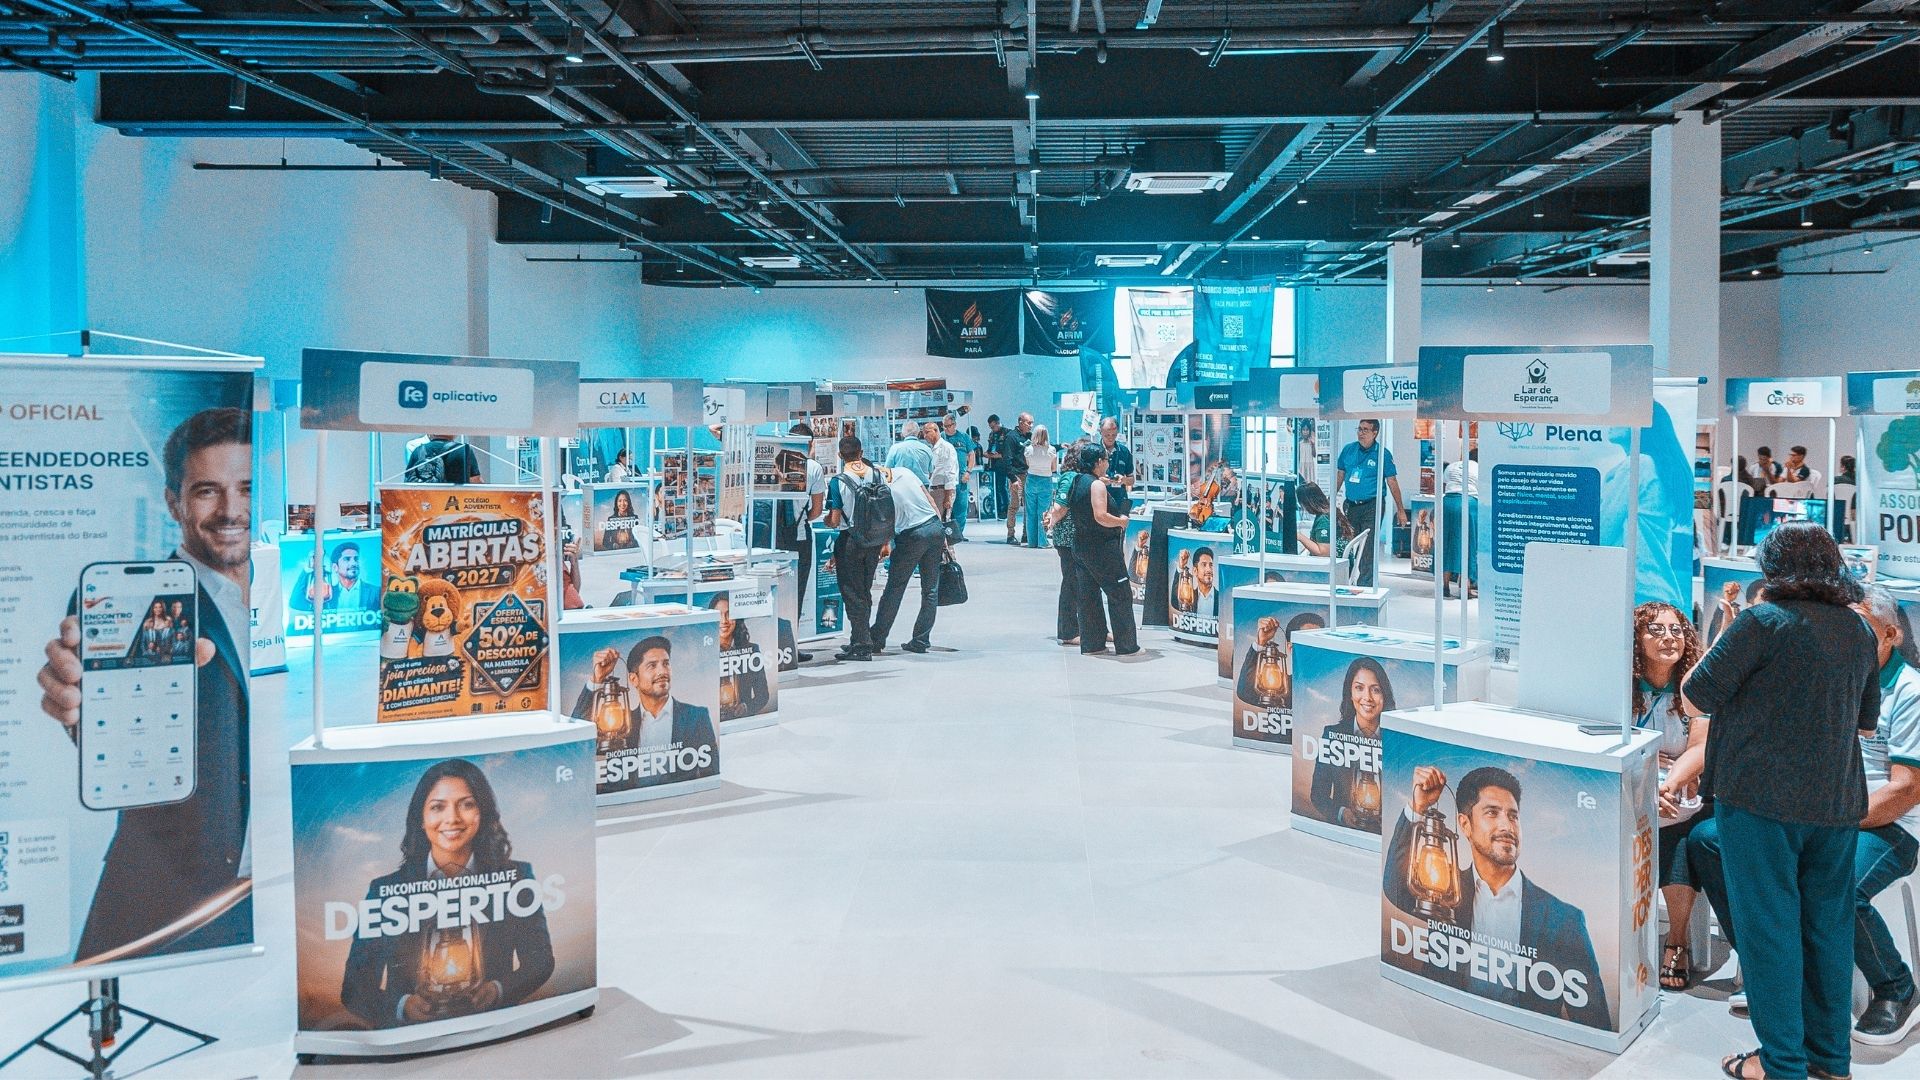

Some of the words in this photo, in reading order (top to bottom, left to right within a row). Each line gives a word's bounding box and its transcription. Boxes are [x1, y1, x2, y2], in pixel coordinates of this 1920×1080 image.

[1391, 380, 1417, 390] Vida
[1522, 386, 1537, 394] Lar
[1540, 386, 1551, 394] de
[433, 391, 498, 403] aplicativo
[600, 392, 646, 405] CIAM
[1393, 391, 1417, 400] Plen
[1514, 394, 1559, 404] Esperança
[10, 405, 104, 421] OFICIAL
[1546, 425, 1602, 442] Plena
[0, 474, 94, 490] NTISTAS
[76, 508, 96, 517] faça
[0, 520, 58, 529] comunidade
[61, 520, 72, 528] de
[428, 521, 518, 541] MATRÍCULAS
[12, 533, 65, 541] adventistas
[68, 532, 80, 540] do
[83, 531, 108, 539] Brasil
[404, 533, 542, 573] ABERTAS
[457, 568, 500, 586] 2027
[734, 591, 768, 599] ASSOCIAÇÃO
[84, 612, 133, 620] ENCONTRO
[491, 616, 528, 624] ESPECIAL!
[495, 609, 524, 617] OFERTA
[252, 637, 271, 648] seja
[479, 624, 525, 648] 50%
[526, 631, 538, 640] DE
[477, 646, 537, 660] DESCONTO
[720, 648, 741, 658] NACIONAL
[484, 661, 494, 669] NA
[495, 658, 529, 667] MATRÍCULA
[720, 650, 773, 677] ERTOS
[383, 669, 405, 689] joia
[405, 663, 448, 681] preciosa
[383, 678, 460, 702] DIAMANTE!
[402, 697, 430, 707] DESCONTO
[431, 693, 456, 702] ESPECIAL!
[1329, 731, 1359, 743] ENCONTRO
[606, 748, 638, 758] ENCONTRO
[638, 744, 668, 754] NACIONAL
[1302, 735, 1382, 773] DESPER
[597, 744, 712, 784] ESPERTOS
[379, 880, 437, 897] ENCONTRO
[438, 871, 491, 888] NACIONAL
[325, 873, 566, 941] DESPERTOS
[1427, 919, 1471, 939] ENCONTRO
[1471, 933, 1514, 953] NACIONAL
[1391, 918, 1589, 1008] DESPERTOS
